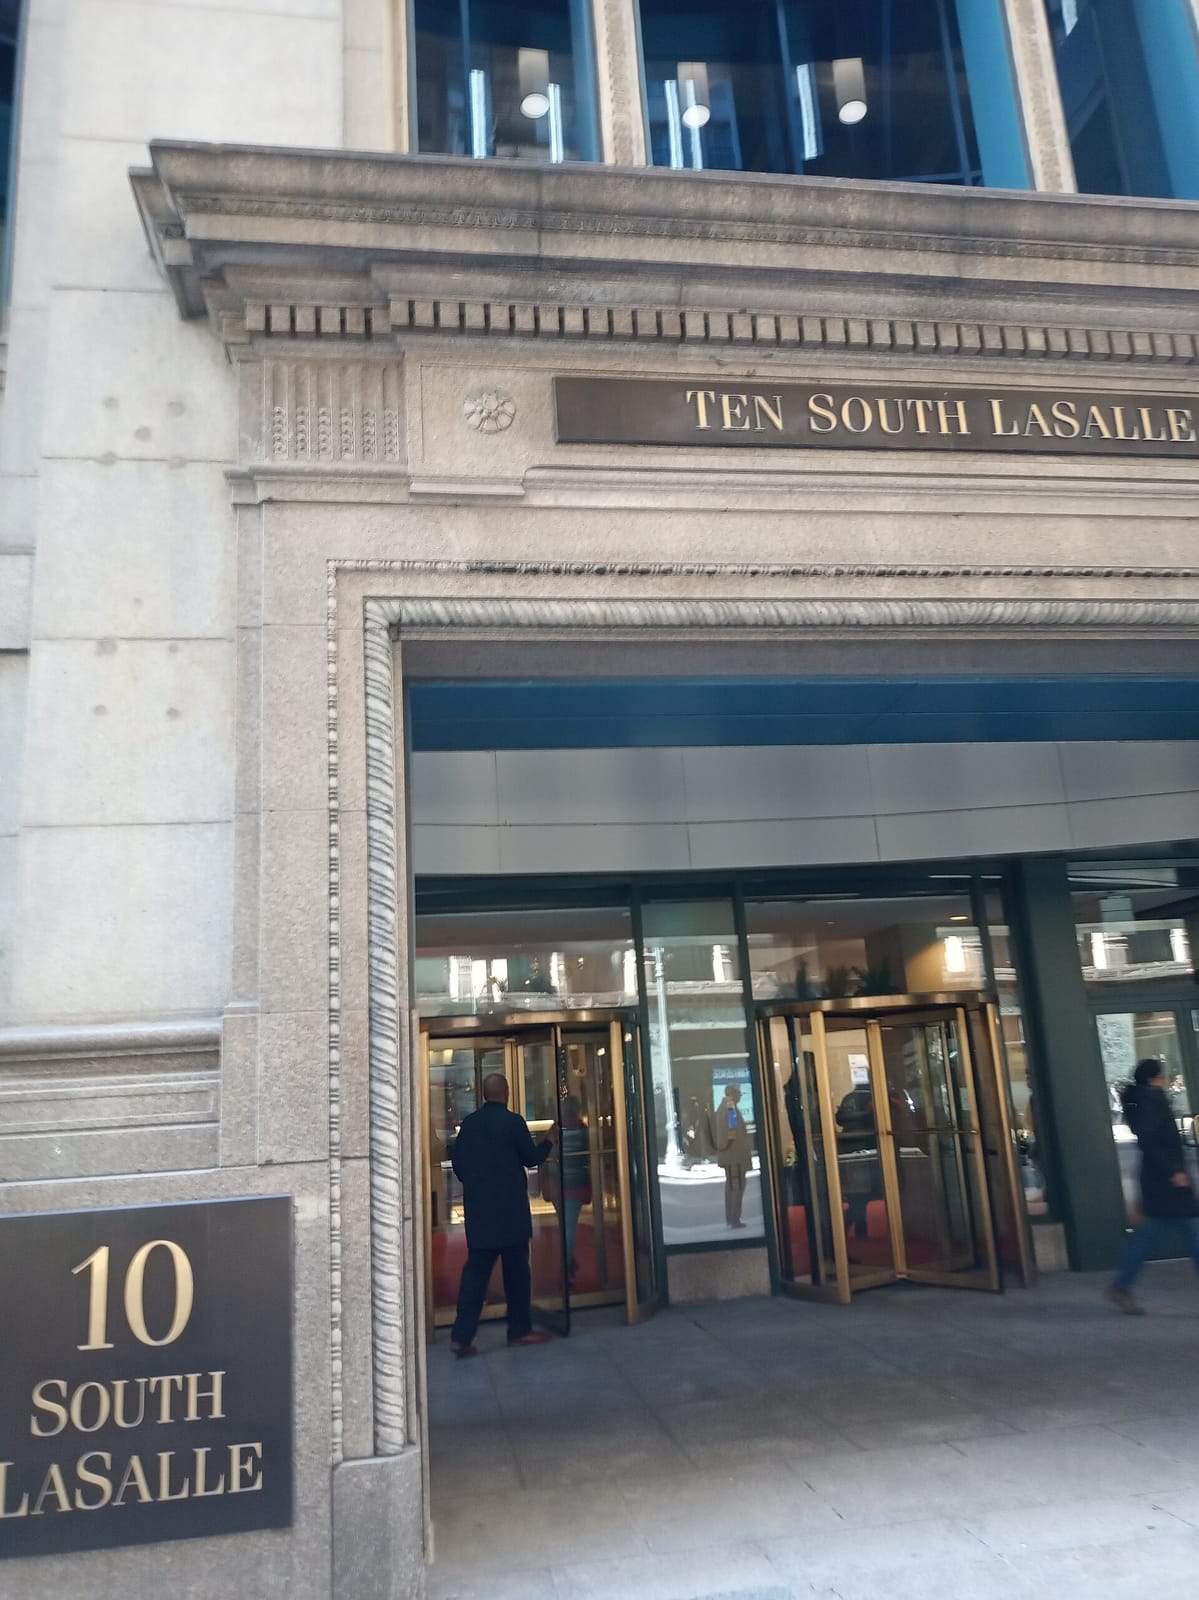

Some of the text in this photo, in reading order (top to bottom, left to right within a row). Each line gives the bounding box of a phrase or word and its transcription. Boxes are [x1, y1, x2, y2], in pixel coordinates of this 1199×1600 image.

[686, 390, 1197, 443] TEN SOUTH LASALLE
[71, 1239, 194, 1350] 10
[30, 1371, 226, 1437] SOUTH
[0, 1442, 263, 1518] LASALLE
